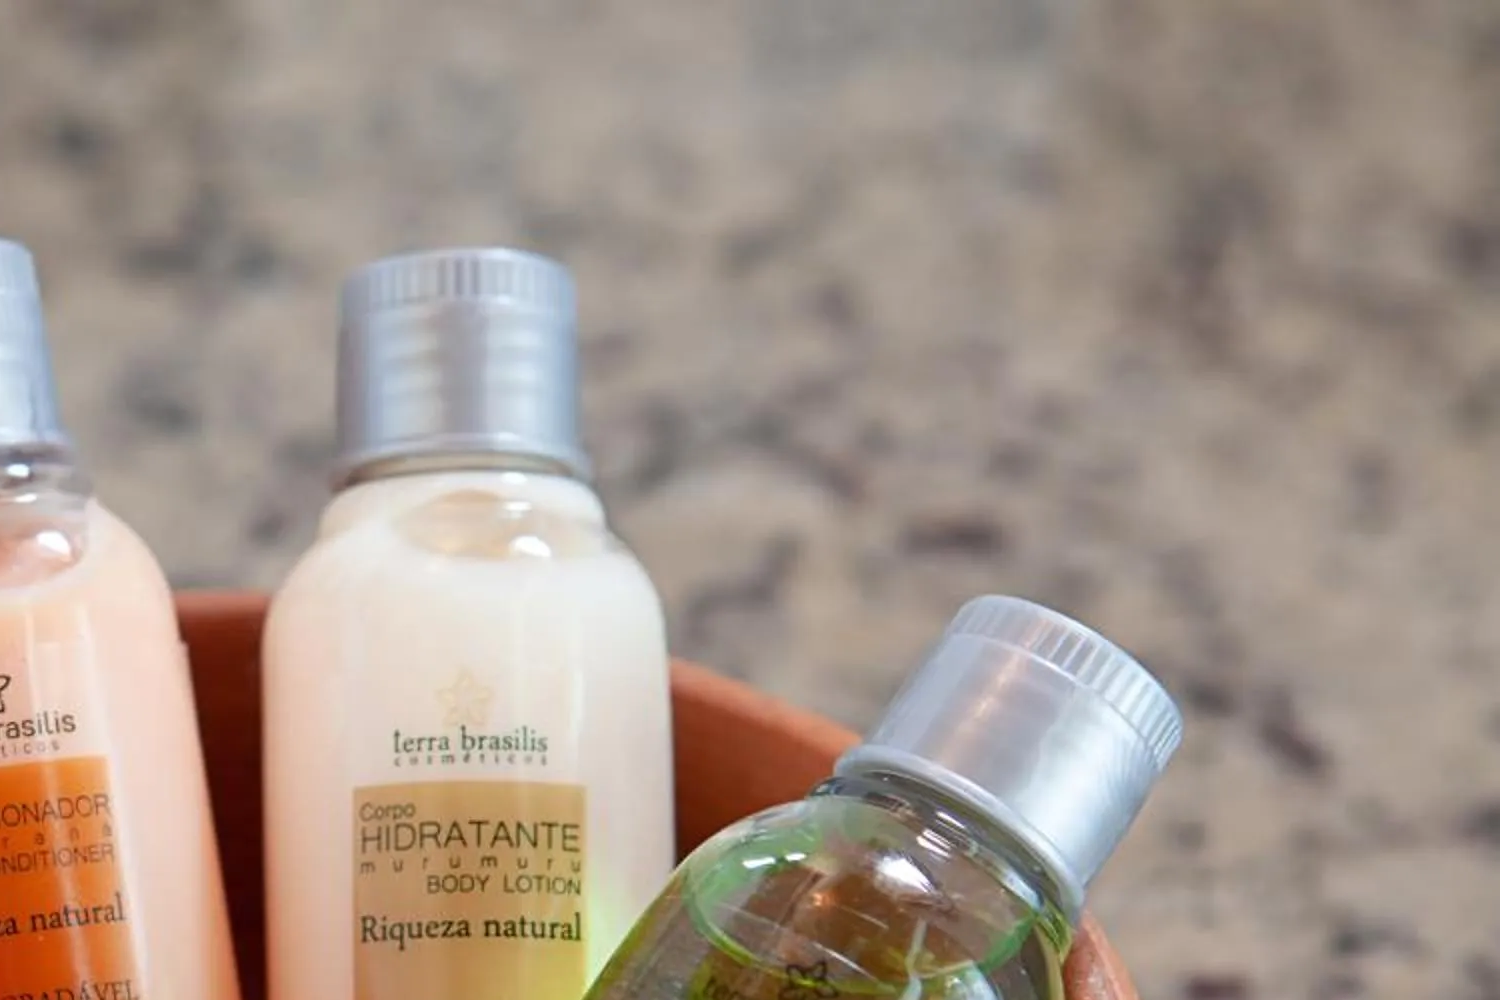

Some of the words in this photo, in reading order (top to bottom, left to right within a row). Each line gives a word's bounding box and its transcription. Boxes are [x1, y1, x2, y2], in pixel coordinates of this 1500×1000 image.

[393, 729, 450, 753] terra
[460, 724, 549, 753] brasilis
[359, 802, 417, 822] Corpo
[360, 819, 582, 854] HIDRATANTE
[359, 854, 582, 875] murumuru
[426, 874, 491, 895] BODY
[503, 875, 583, 896] LOTION
[29, 891, 127, 933] natural
[360, 913, 472, 951] Riqueza
[483, 911, 583, 942] natural
